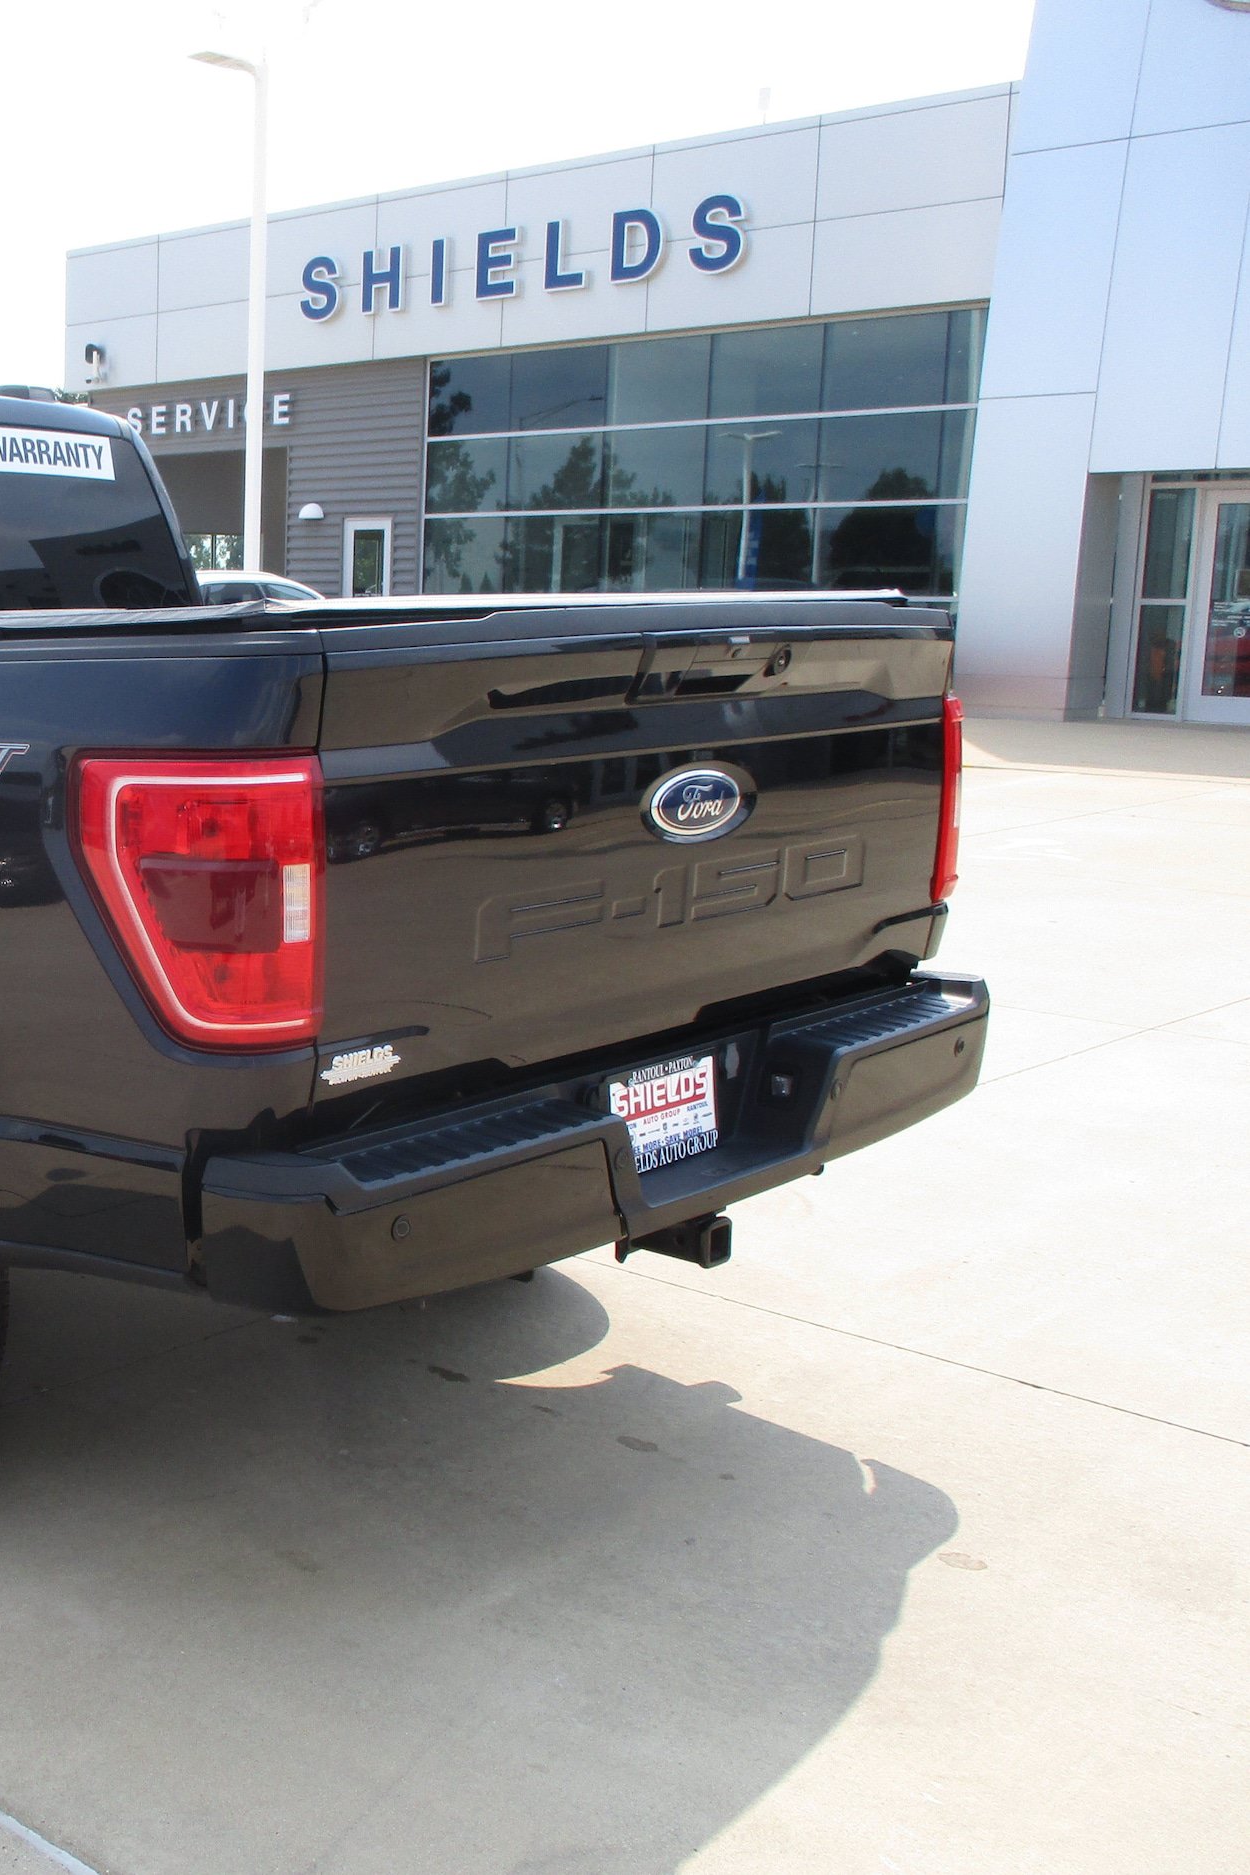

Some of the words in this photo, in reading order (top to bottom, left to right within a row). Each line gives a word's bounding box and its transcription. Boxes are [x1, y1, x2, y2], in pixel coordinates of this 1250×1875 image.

[299, 193, 748, 324] SHIELDS
[126, 393, 291, 435] SERVIE
[676, 784, 725, 822] Ford
[474, 834, 867, 965] F-150
[613, 1064, 710, 1118] SHIELDS
[631, 1063, 666, 1084] RANTOUL
[634, 1149, 659, 1174] ELDS
[659, 1141, 687, 1167] AUTO
[686, 1129, 719, 1156] GROUP
